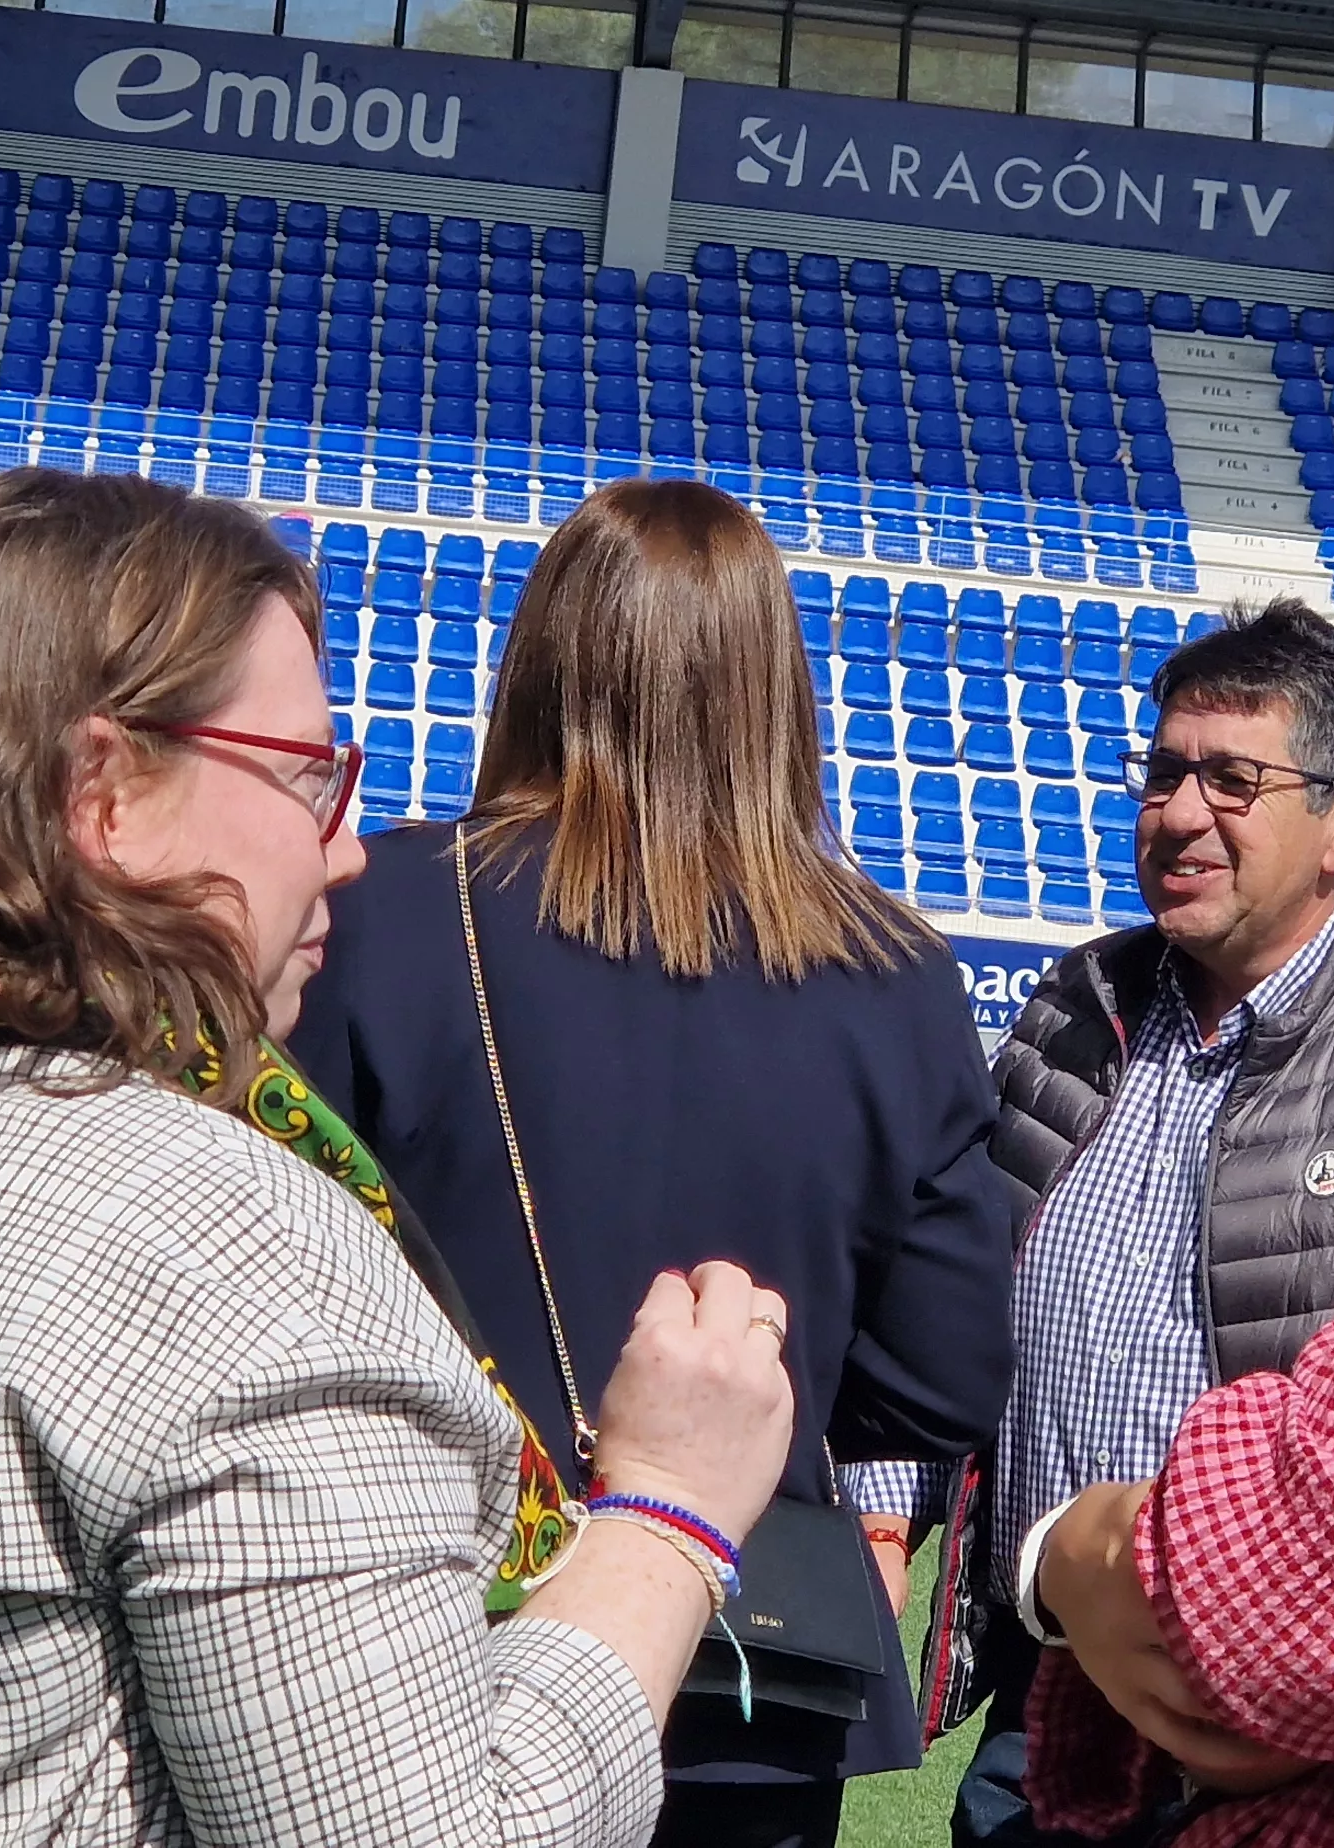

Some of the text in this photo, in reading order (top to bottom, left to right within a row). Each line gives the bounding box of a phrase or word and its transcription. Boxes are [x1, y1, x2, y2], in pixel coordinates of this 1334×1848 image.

[73, 47, 462, 160] embou
[823, 136, 1292, 238] ARAGÓN TV
[1187, 348, 1216, 359] FILA
[1202, 386, 1231, 398] FILA
[1210, 422, 1240, 434] FILA
[1218, 458, 1248, 471] FILA
[1226, 497, 1256, 509] FILA
[1234, 537, 1265, 548] FILA
[998, 1009, 1009, 1025] Y
